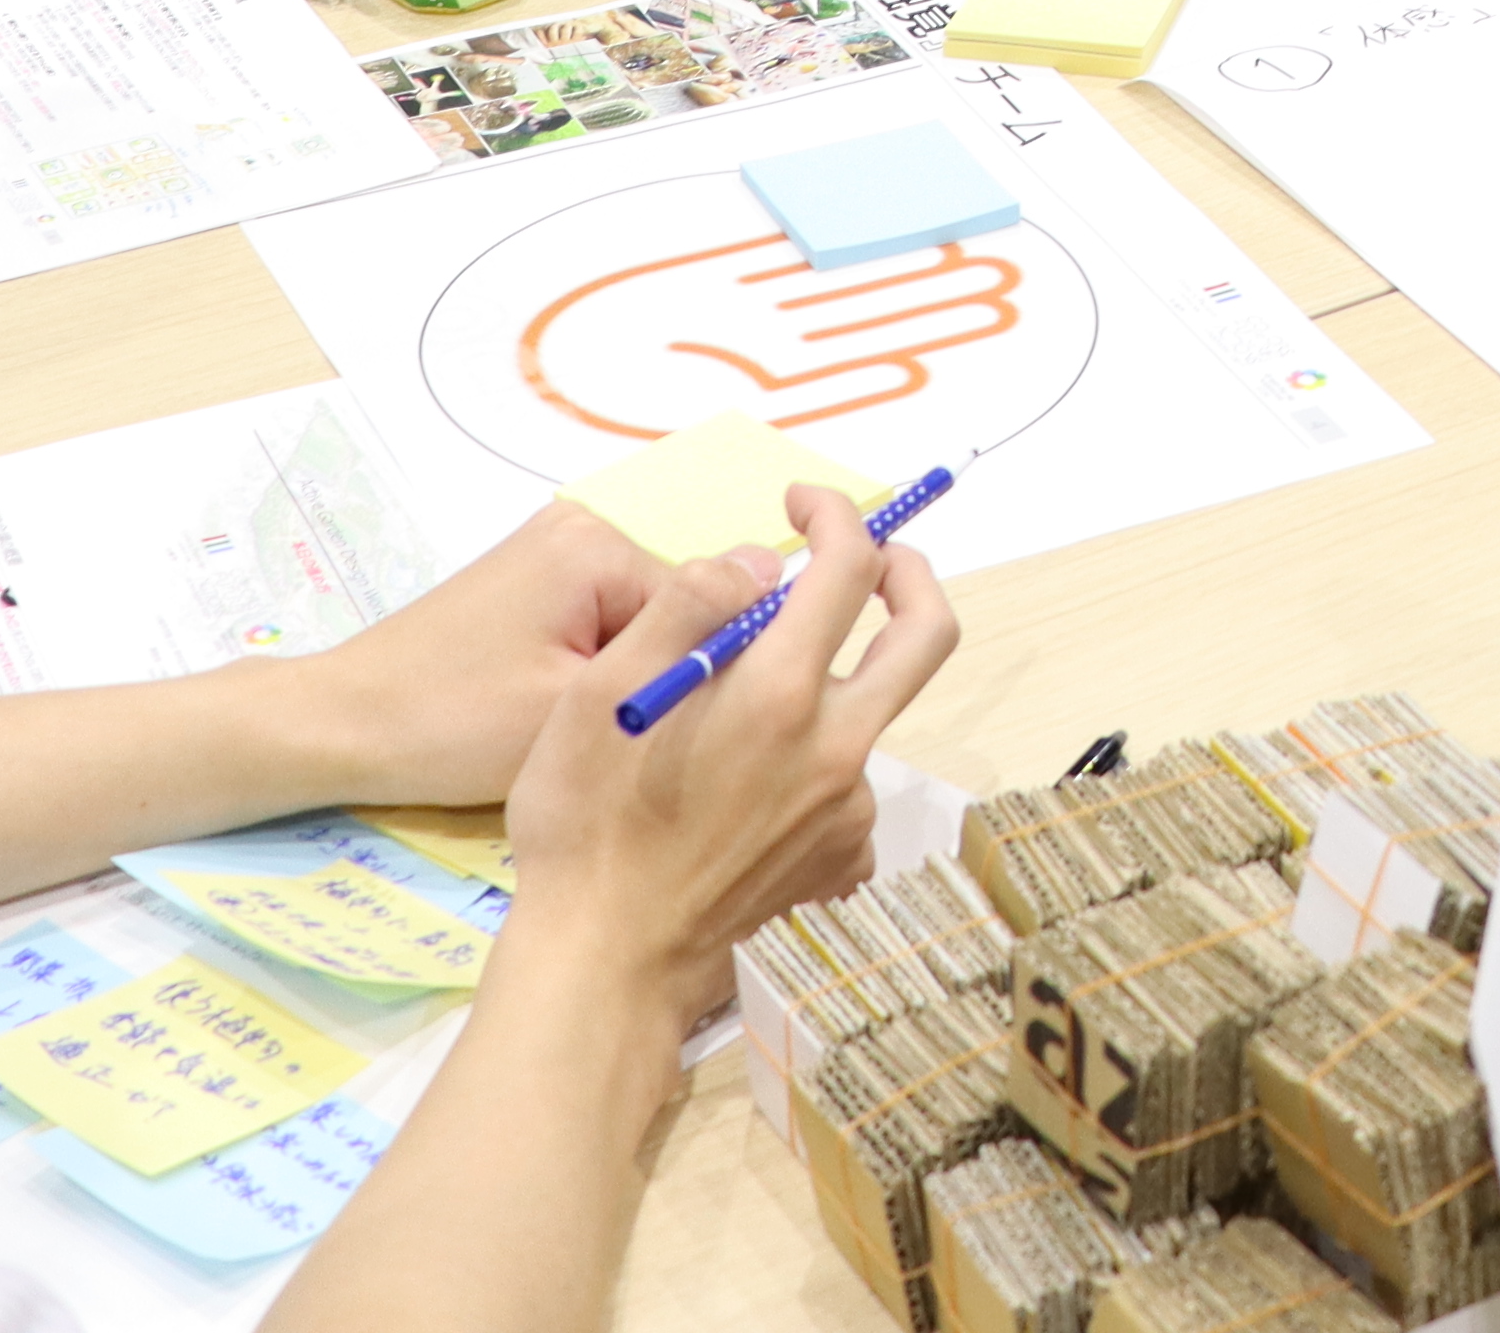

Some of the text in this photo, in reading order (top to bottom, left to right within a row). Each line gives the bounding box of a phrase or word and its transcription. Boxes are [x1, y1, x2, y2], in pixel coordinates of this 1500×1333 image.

[954, 65, 1063, 147] チーム
[361, 587, 388, 621] Work
